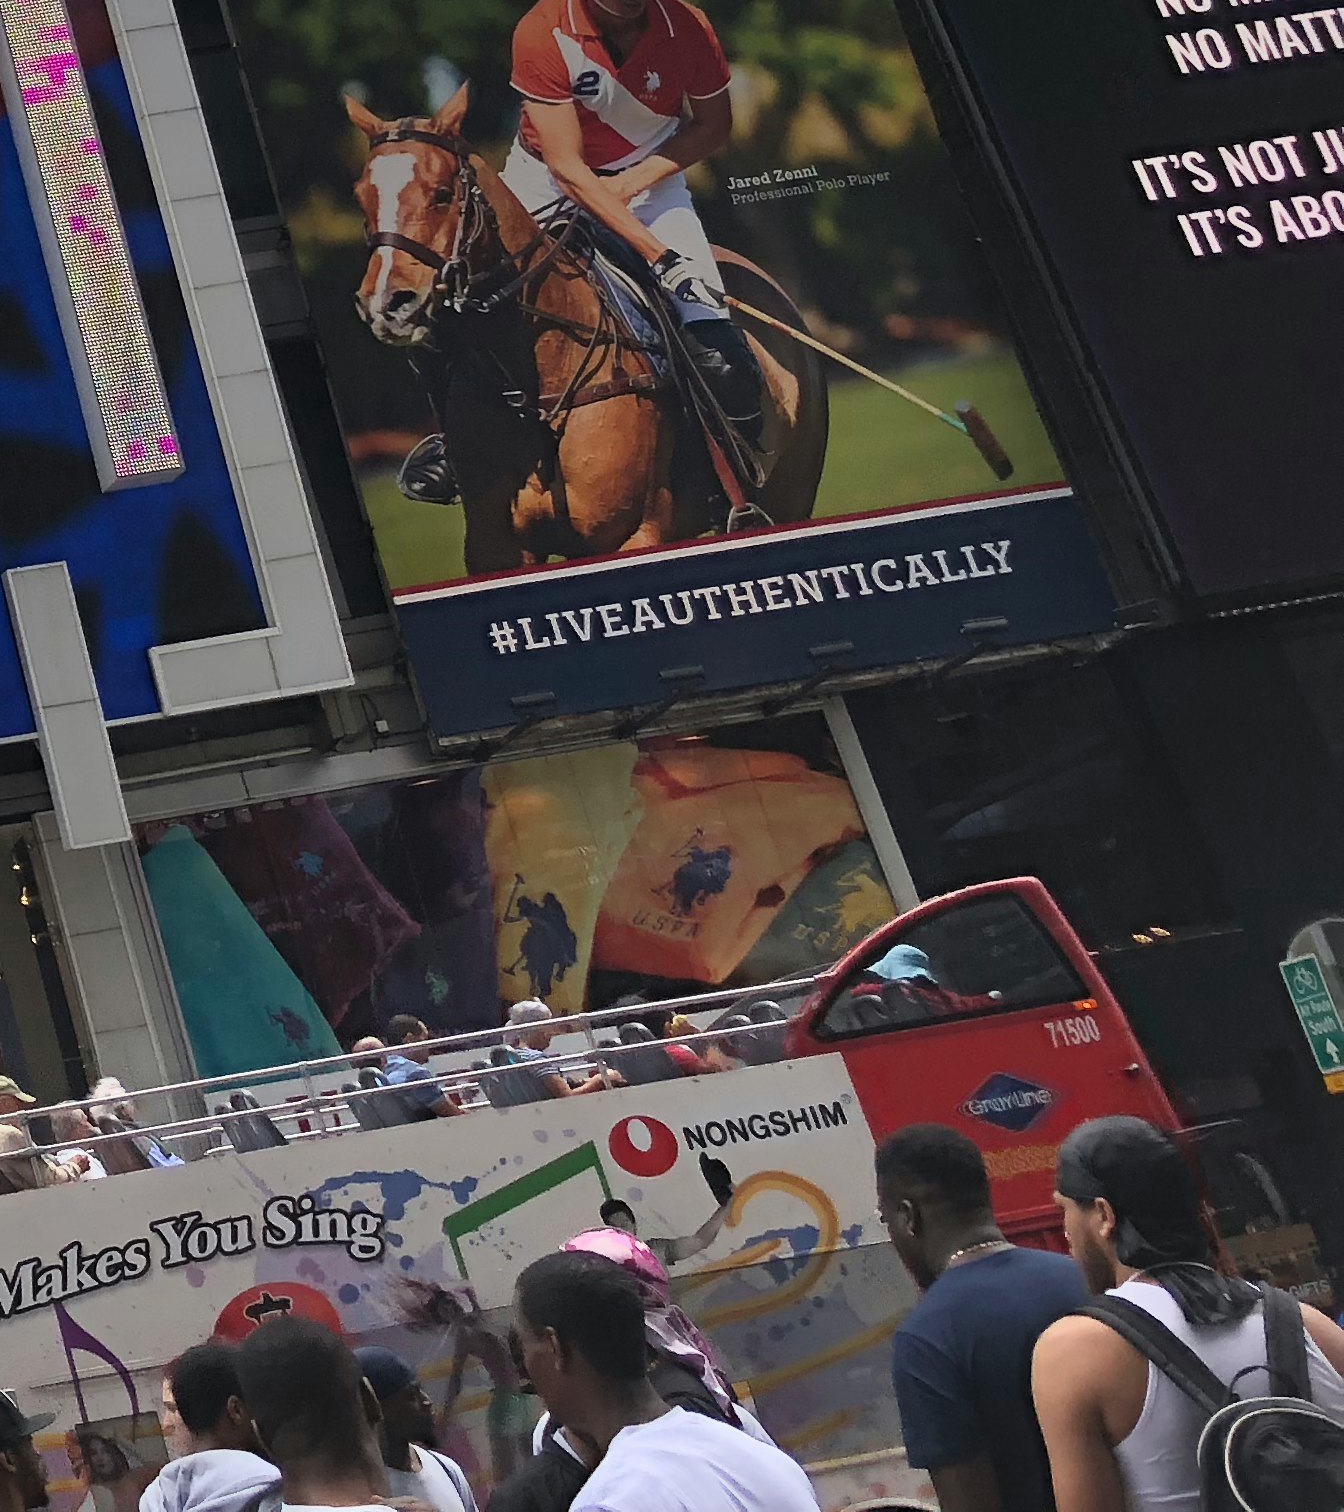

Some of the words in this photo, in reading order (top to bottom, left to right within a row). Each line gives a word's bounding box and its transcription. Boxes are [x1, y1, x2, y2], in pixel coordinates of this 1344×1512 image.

[1165, 28, 1233, 74] NO
[1235, 7, 1344, 64] MATT
[575, 70, 600, 97] 2
[727, 171, 771, 191] Jared
[772, 164, 818, 183] Zenni
[731, 182, 814, 206] Professional
[815, 176, 846, 193] Polo
[847, 169, 892, 190] Player
[1132, 151, 1217, 201] IT'S
[1218, 135, 1306, 188] NOT
[1177, 205, 1264, 257] IT'S
[488, 538, 1015, 656] #LIVEAUTHENTICALLY
[1043, 1014, 1101, 1049] 71500
[682, 1100, 848, 1150] NONGSHIM
[151, 1209, 254, 1269] You
[261, 1192, 385, 1262] Sing
